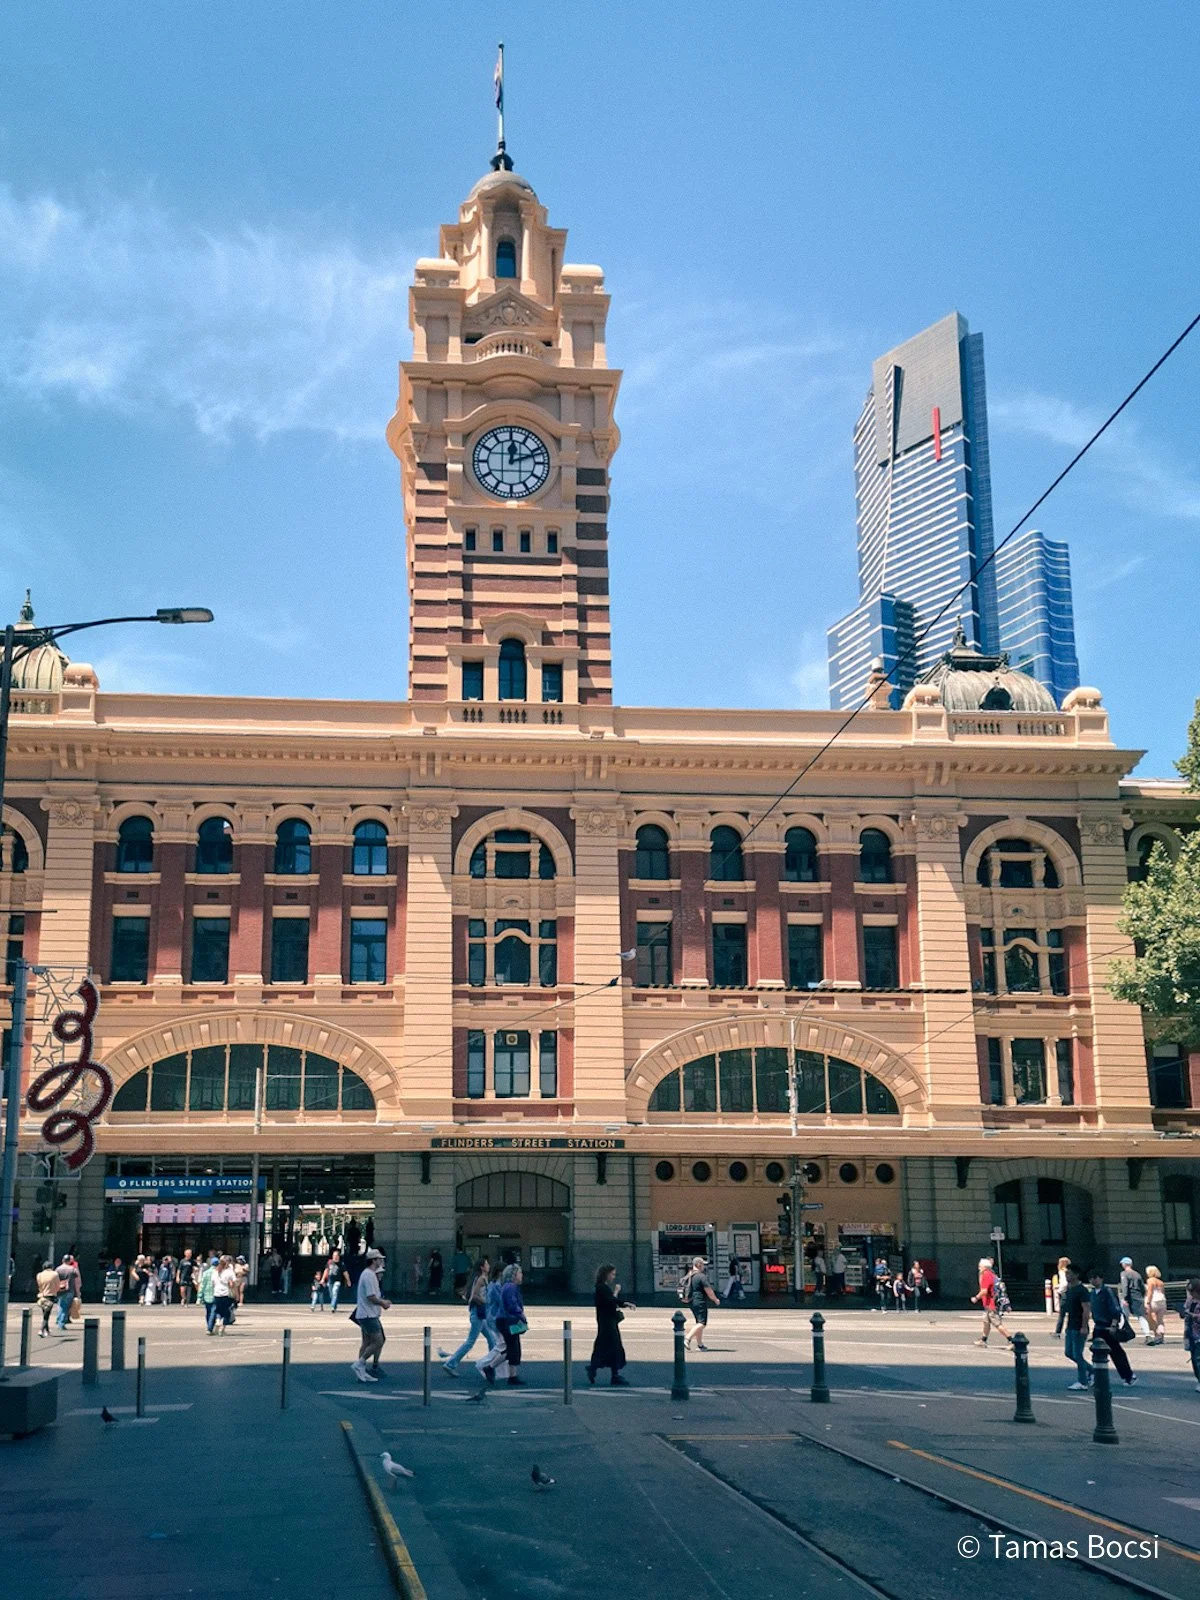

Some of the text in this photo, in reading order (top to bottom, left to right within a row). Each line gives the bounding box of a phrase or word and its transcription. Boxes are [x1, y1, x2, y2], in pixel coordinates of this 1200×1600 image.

[440, 1138, 616, 1149] FLINDERS STREET STATION
[129, 1179, 175, 1187] FLINDERS
[178, 1179, 212, 1187] STREET
